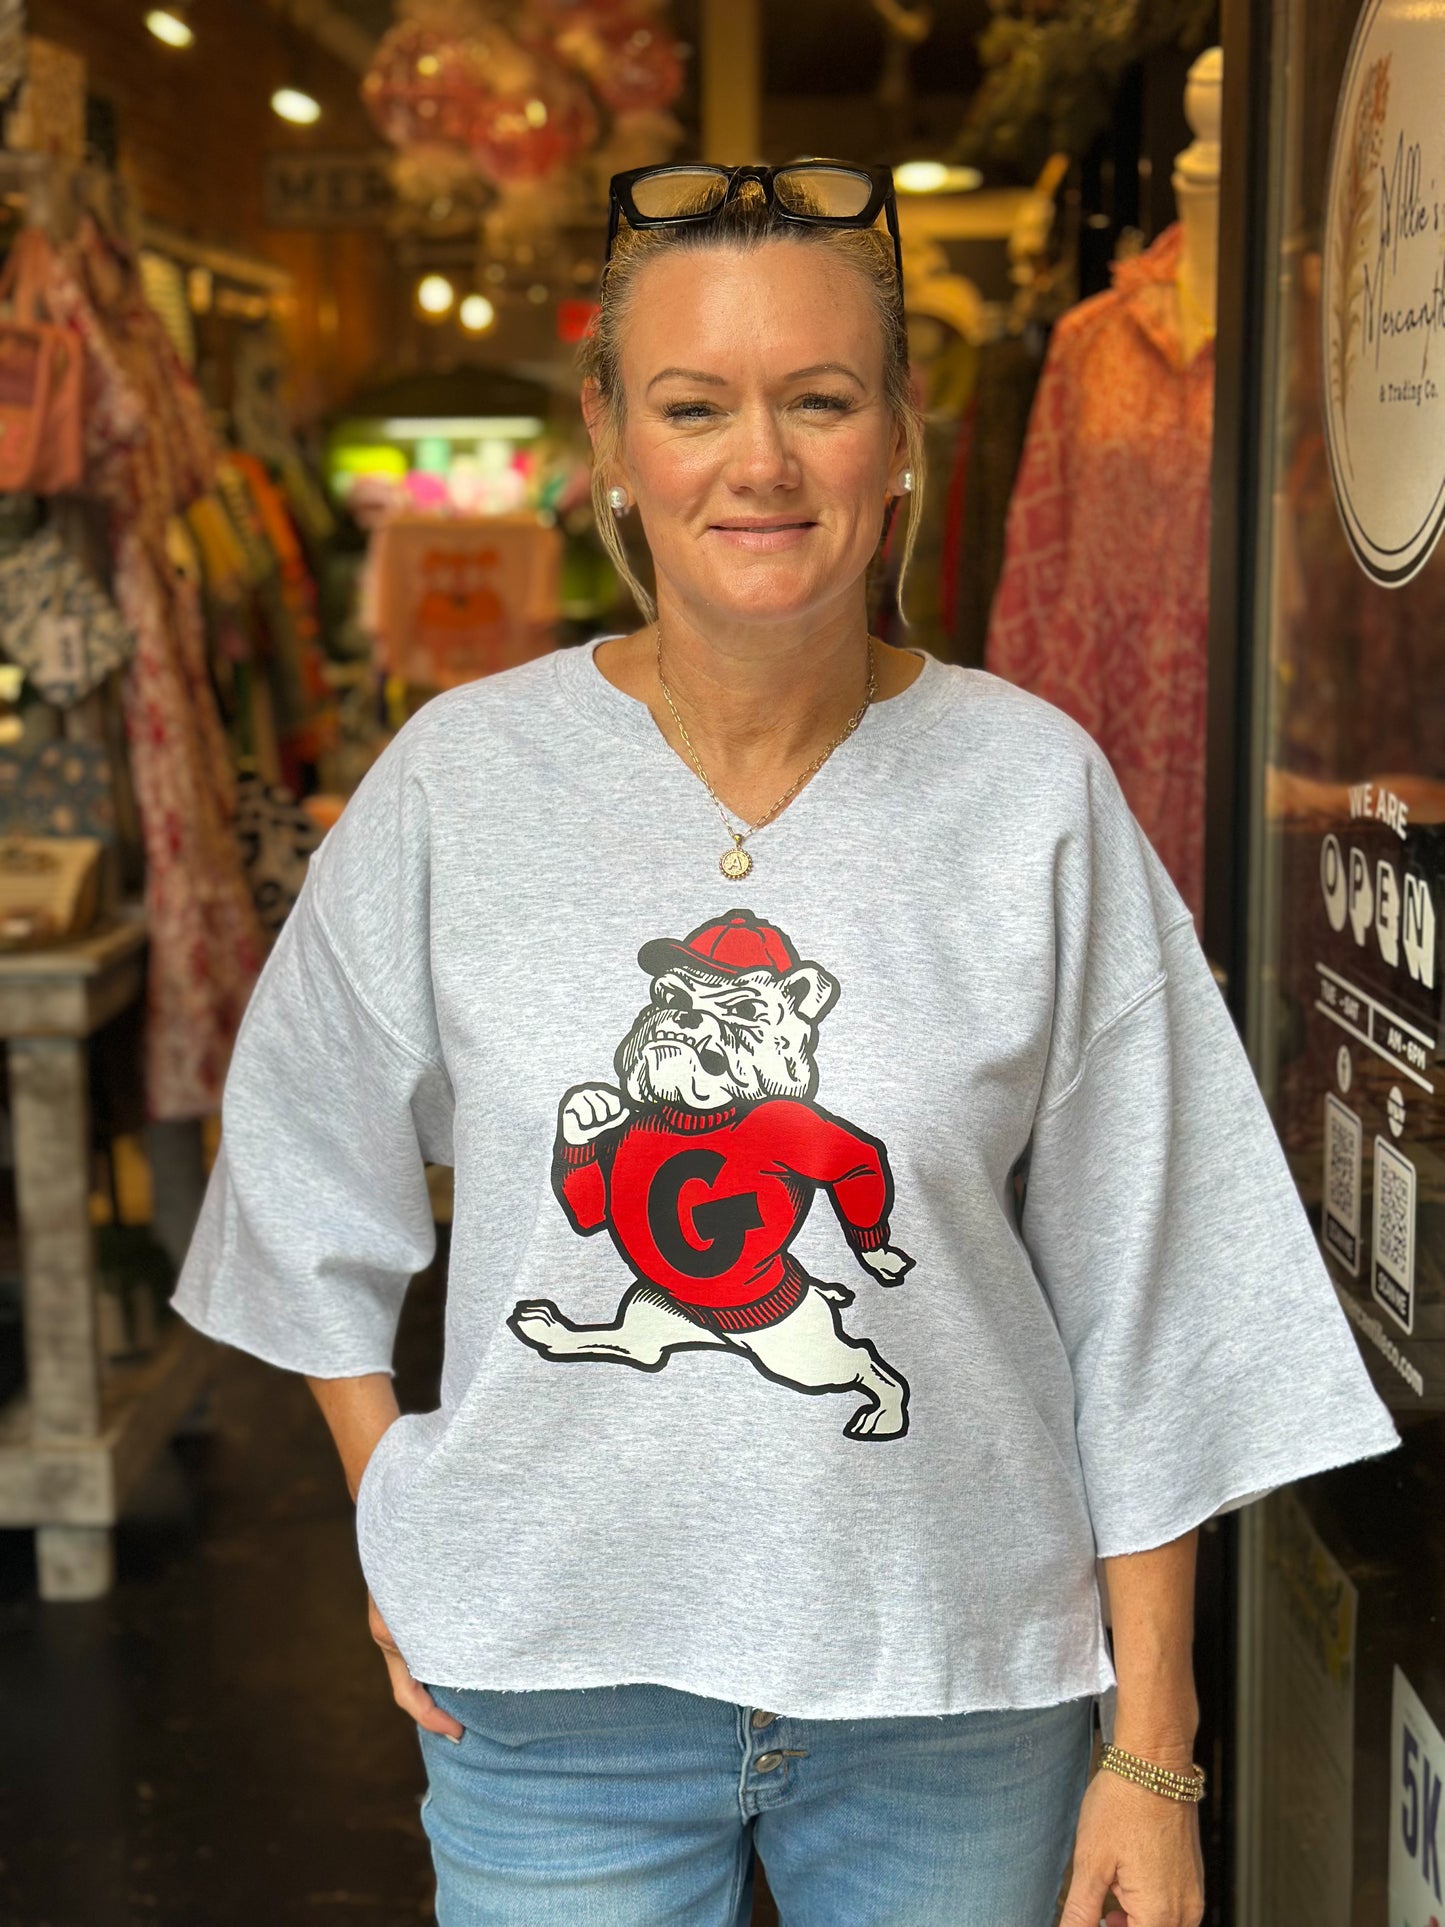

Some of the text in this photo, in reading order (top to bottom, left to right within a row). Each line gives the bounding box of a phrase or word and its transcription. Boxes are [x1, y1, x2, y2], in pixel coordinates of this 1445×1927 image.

[1380, 129, 1439, 276] Millie's
[1388, 380, 1422, 406] Trading
[1424, 379, 1439, 399] Co.
[727, 855, 743, 871] A
[1348, 783, 1408, 841] WE ARE
[1319, 833, 1436, 989] OPEN
[647, 1149, 765, 1278] G
[1402, 1722, 1443, 1907] 5K
